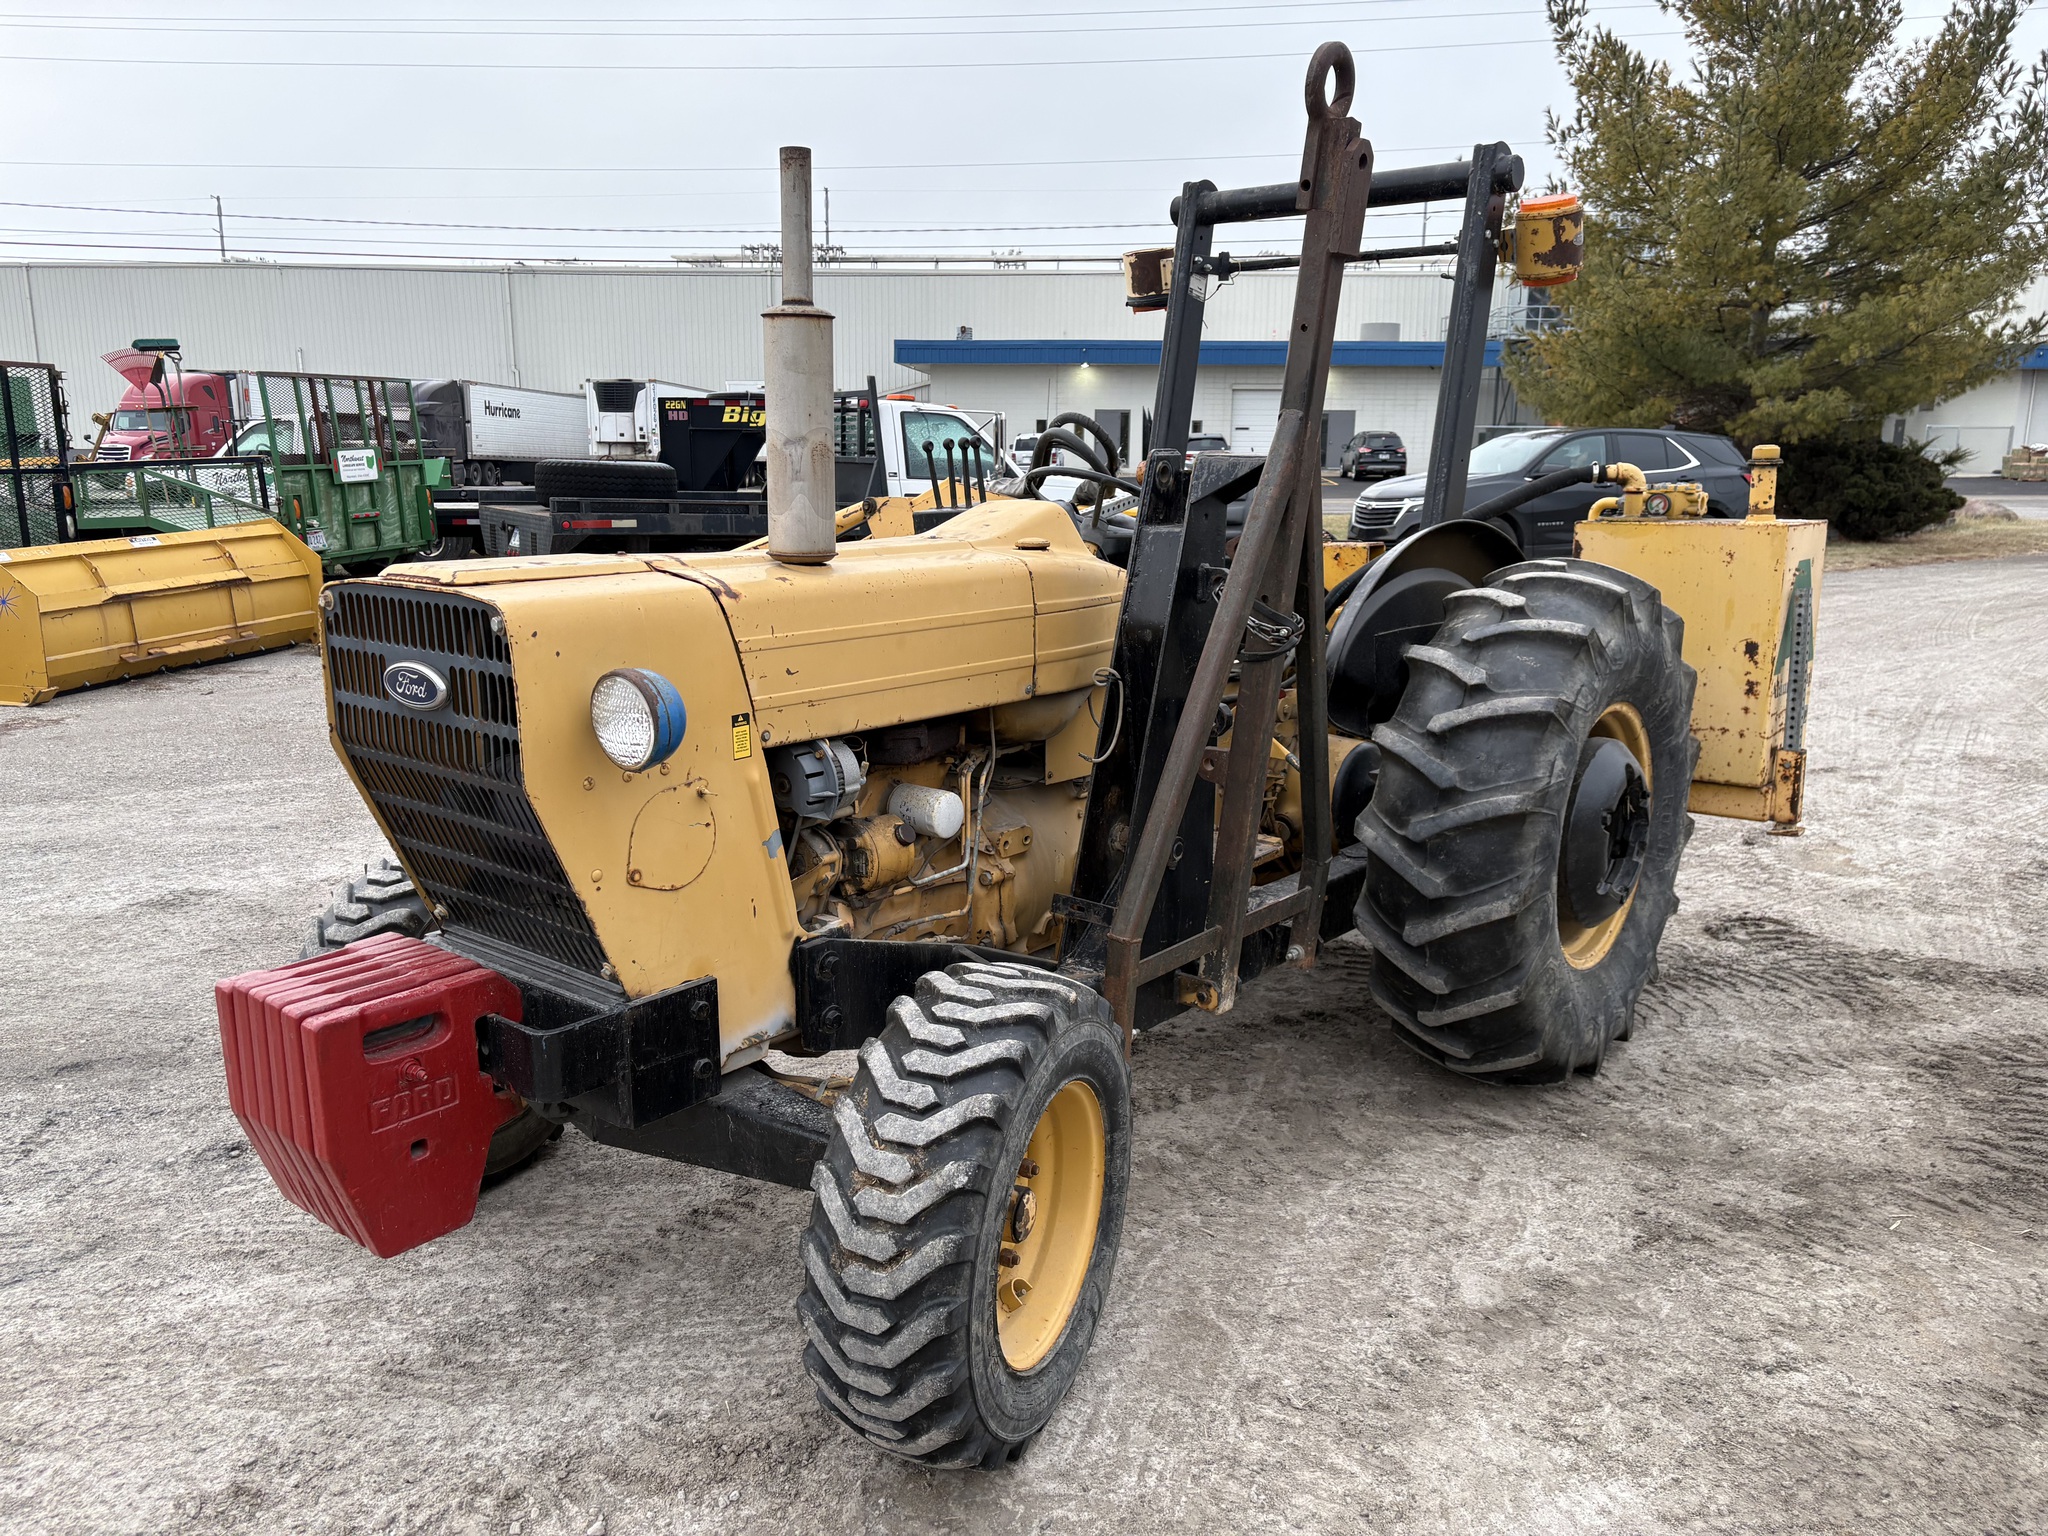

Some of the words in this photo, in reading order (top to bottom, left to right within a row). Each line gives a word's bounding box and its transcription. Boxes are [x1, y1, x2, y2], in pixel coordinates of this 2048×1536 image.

[484, 400, 521, 419] Hurricane
[668, 410, 688, 421] HD
[722, 406, 766, 427] Big
[395, 671, 427, 698] Ford
[370, 1077, 455, 1127] FORD
